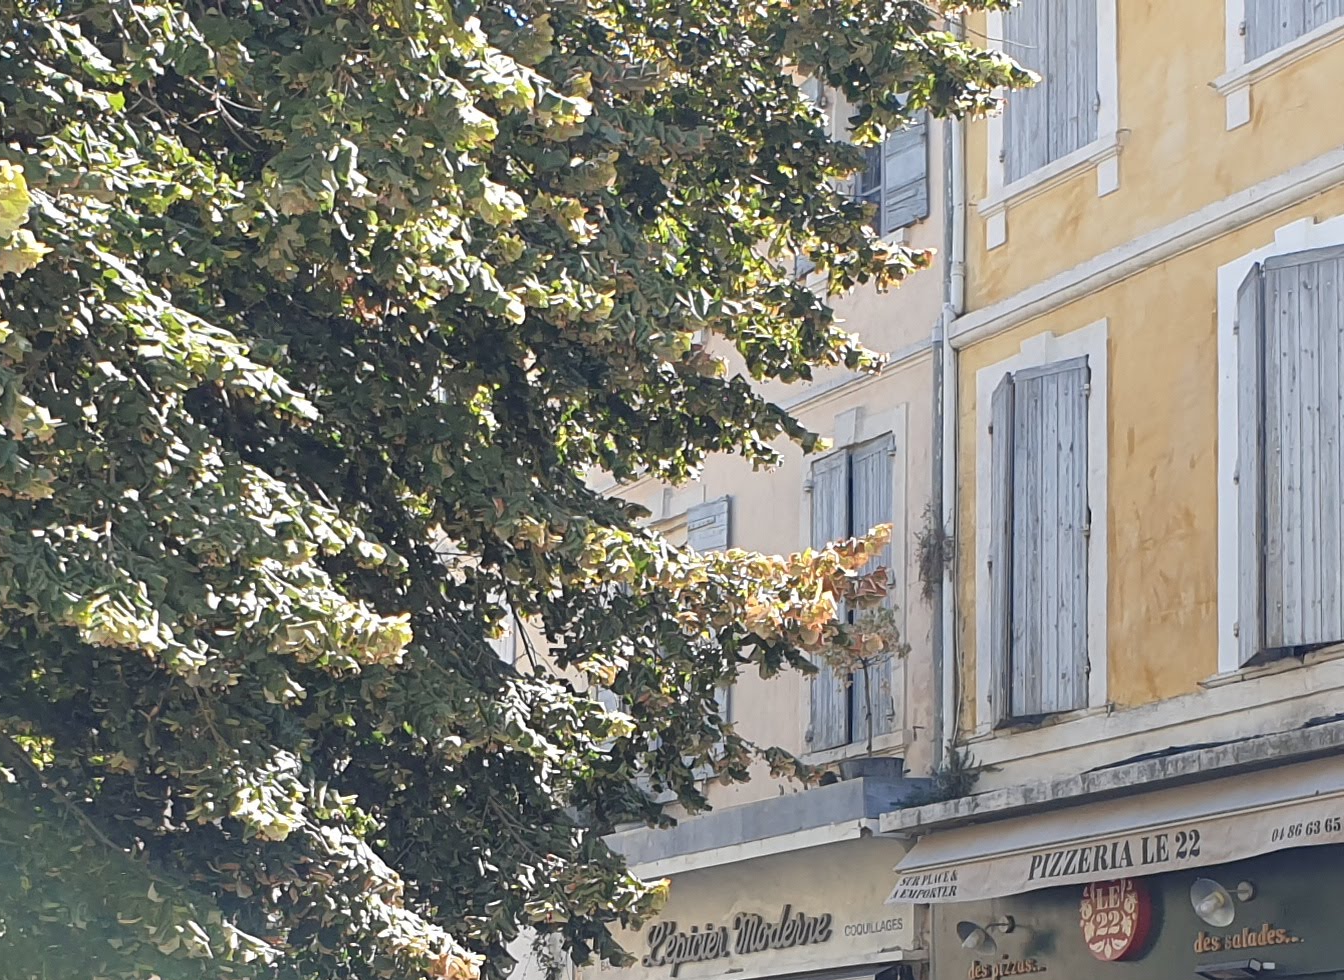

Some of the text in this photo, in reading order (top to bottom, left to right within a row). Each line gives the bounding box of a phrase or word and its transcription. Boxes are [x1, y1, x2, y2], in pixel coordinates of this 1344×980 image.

[1271, 827, 1285, 843] 04
[1287, 823, 1303, 839] 86
[1305, 819, 1322, 836] 63
[1324, 816, 1341, 833] 65
[1027, 828, 1202, 881] PIZZERIA LE 22
[899, 869, 958, 887] SUR PLACE &
[899, 885, 957, 899] EMPORTER
[1094, 886, 1121, 909] LE
[733, 903, 833, 954] Moderne
[843, 917, 904, 937] COQUILLAGES
[1094, 911, 1123, 935] 22
[1193, 930, 1222, 953] des
[968, 960, 991, 980] des
